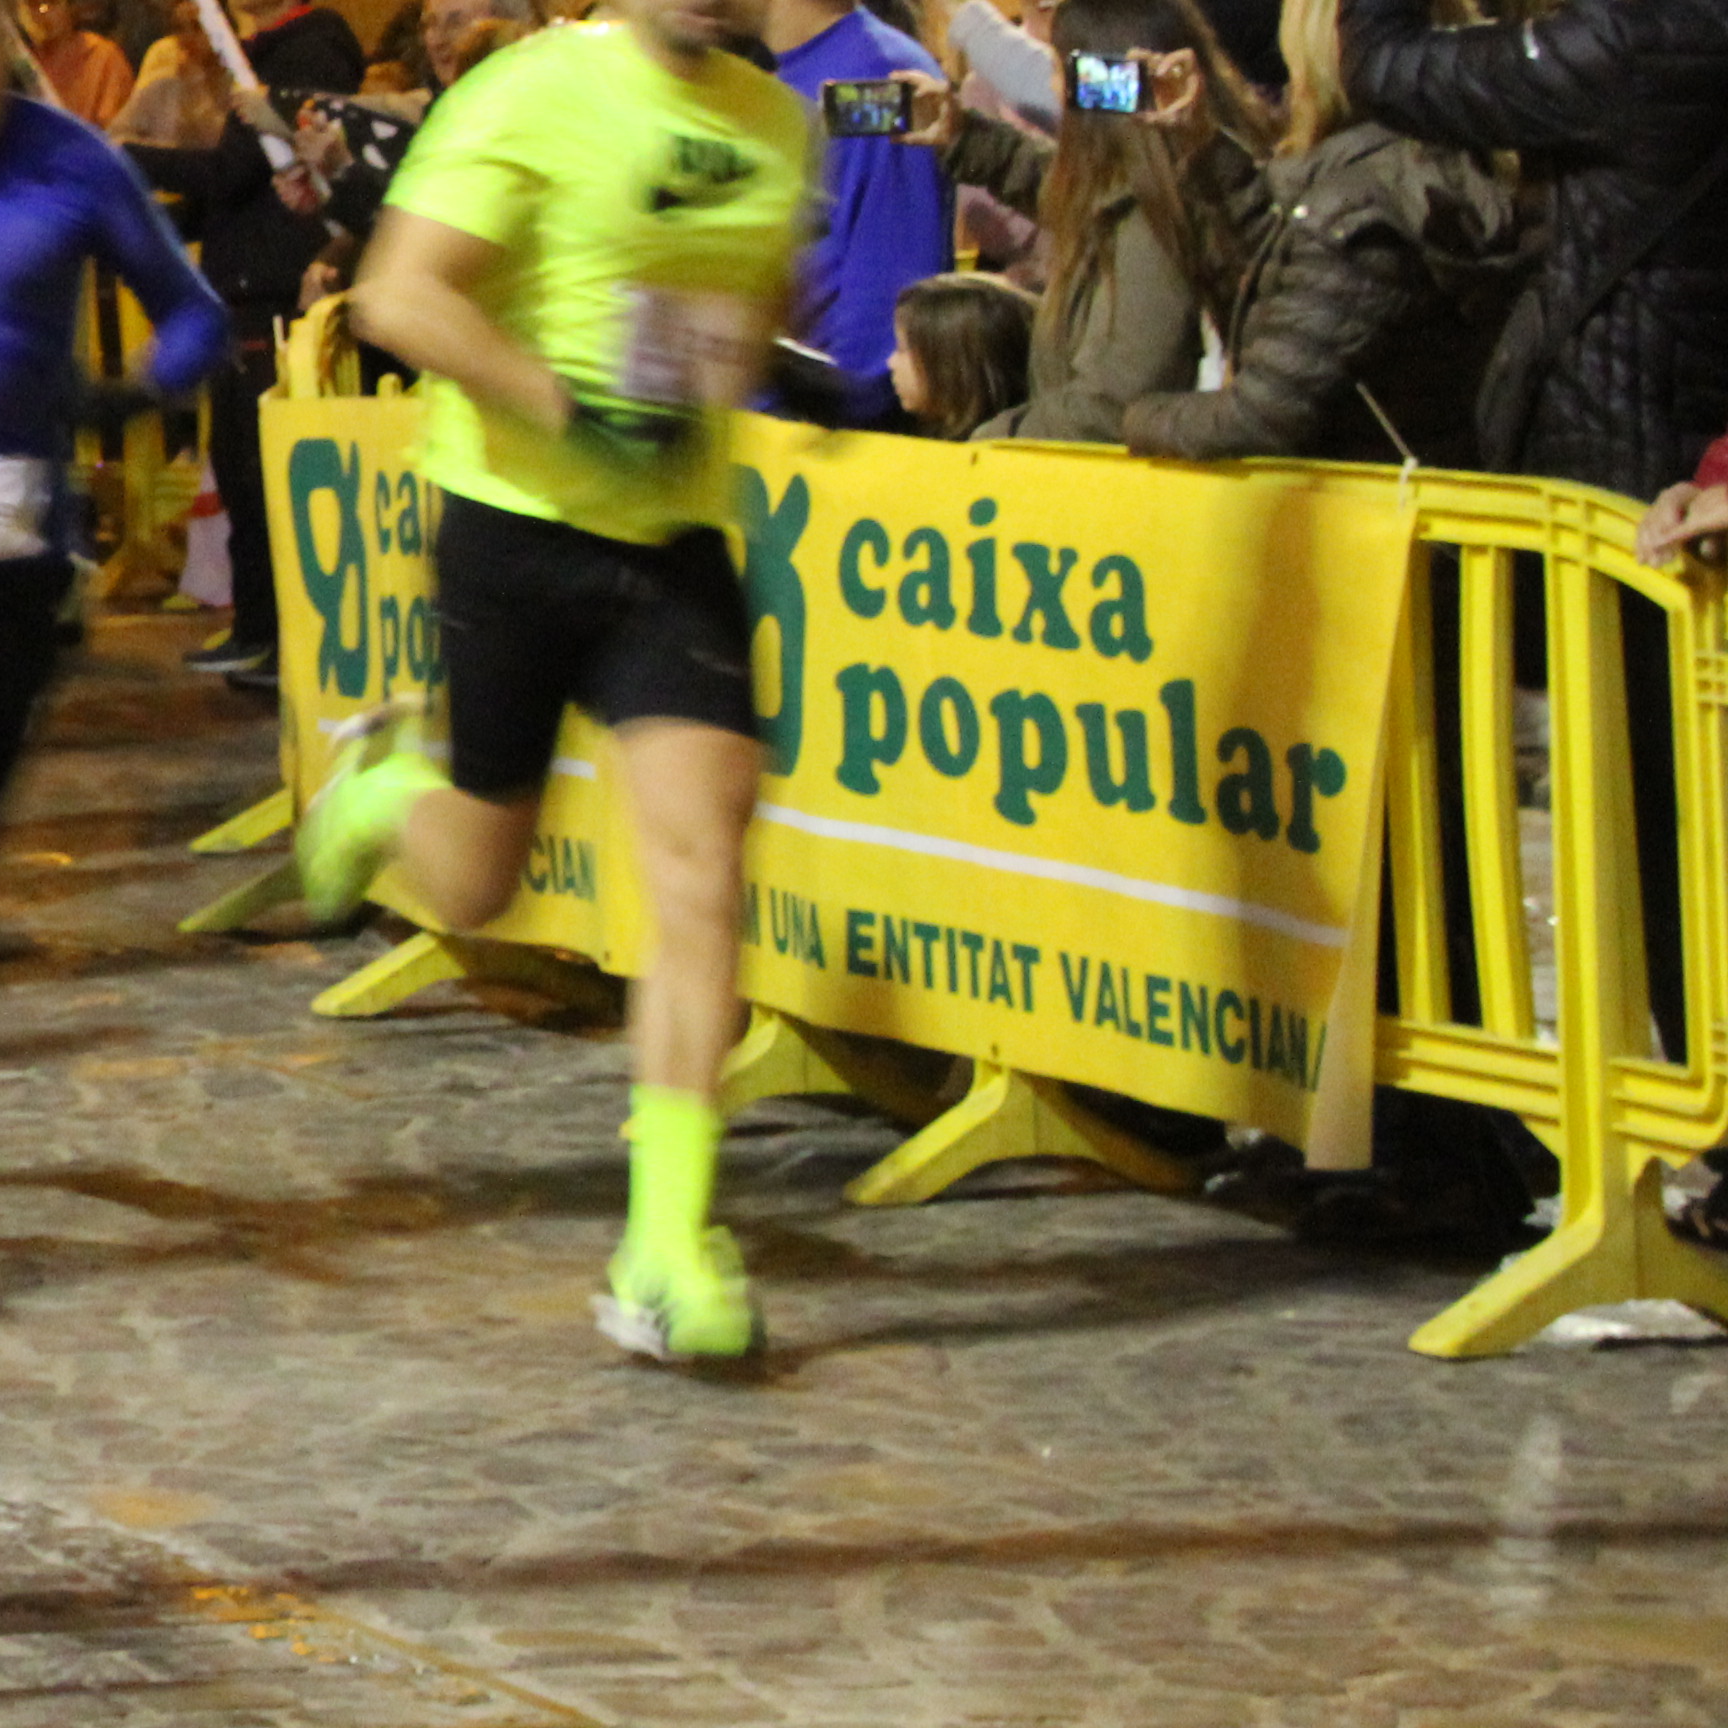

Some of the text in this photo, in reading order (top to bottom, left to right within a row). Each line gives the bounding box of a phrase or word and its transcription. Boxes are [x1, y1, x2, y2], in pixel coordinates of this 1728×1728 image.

[838, 497, 1154, 664] caixa
[835, 662, 1347, 854] popular
[769, 887, 828, 970] UNA
[846, 908, 1041, 1014] ENTITAT
